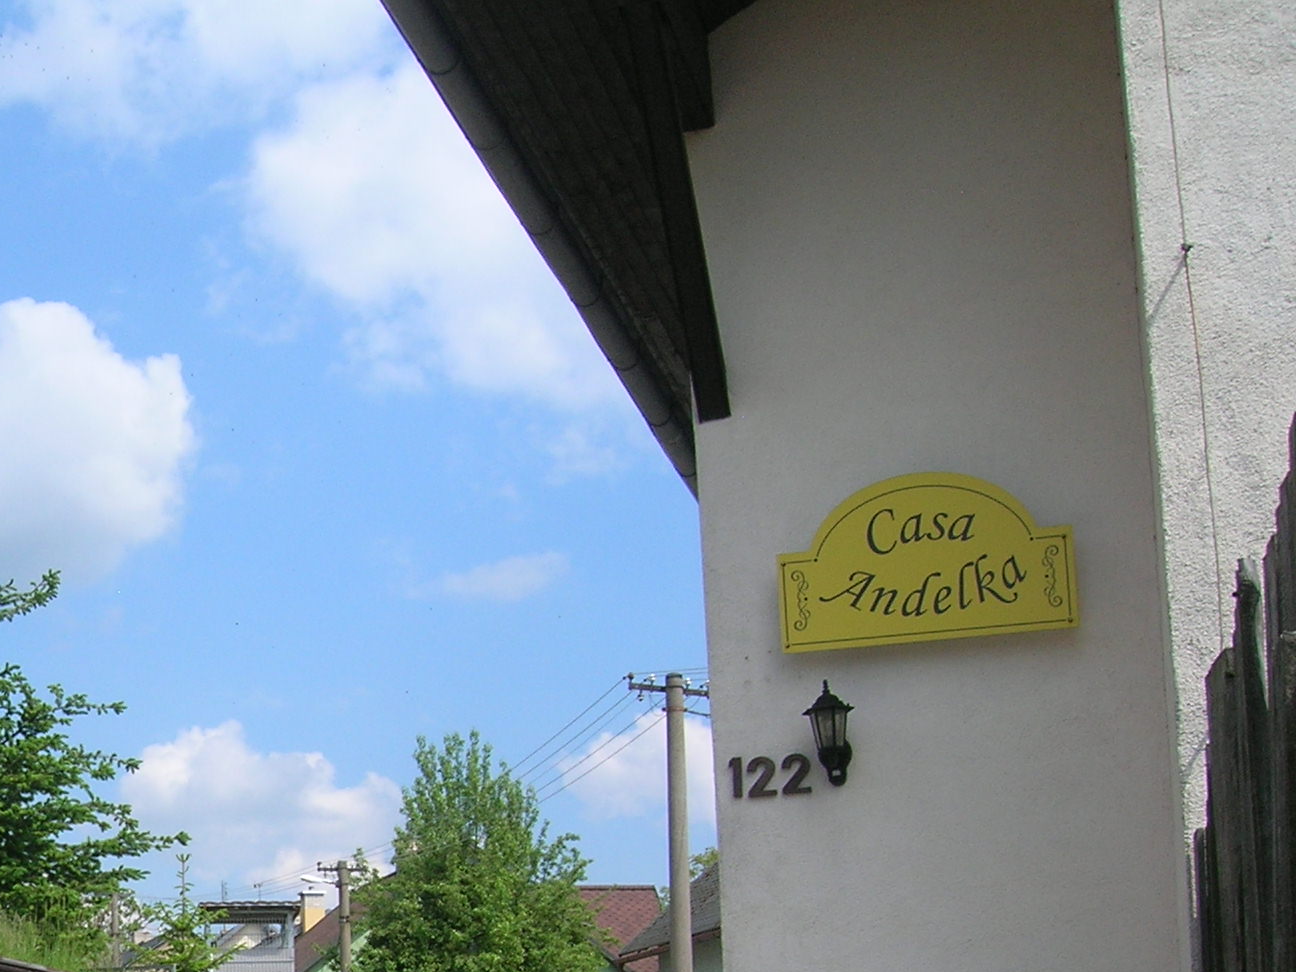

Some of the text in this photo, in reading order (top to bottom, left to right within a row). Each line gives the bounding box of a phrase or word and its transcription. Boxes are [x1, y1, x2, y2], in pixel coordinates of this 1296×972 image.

[867, 508, 976, 555] Casa
[819, 554, 1027, 617] Andelka
[729, 754, 812, 798] 122
